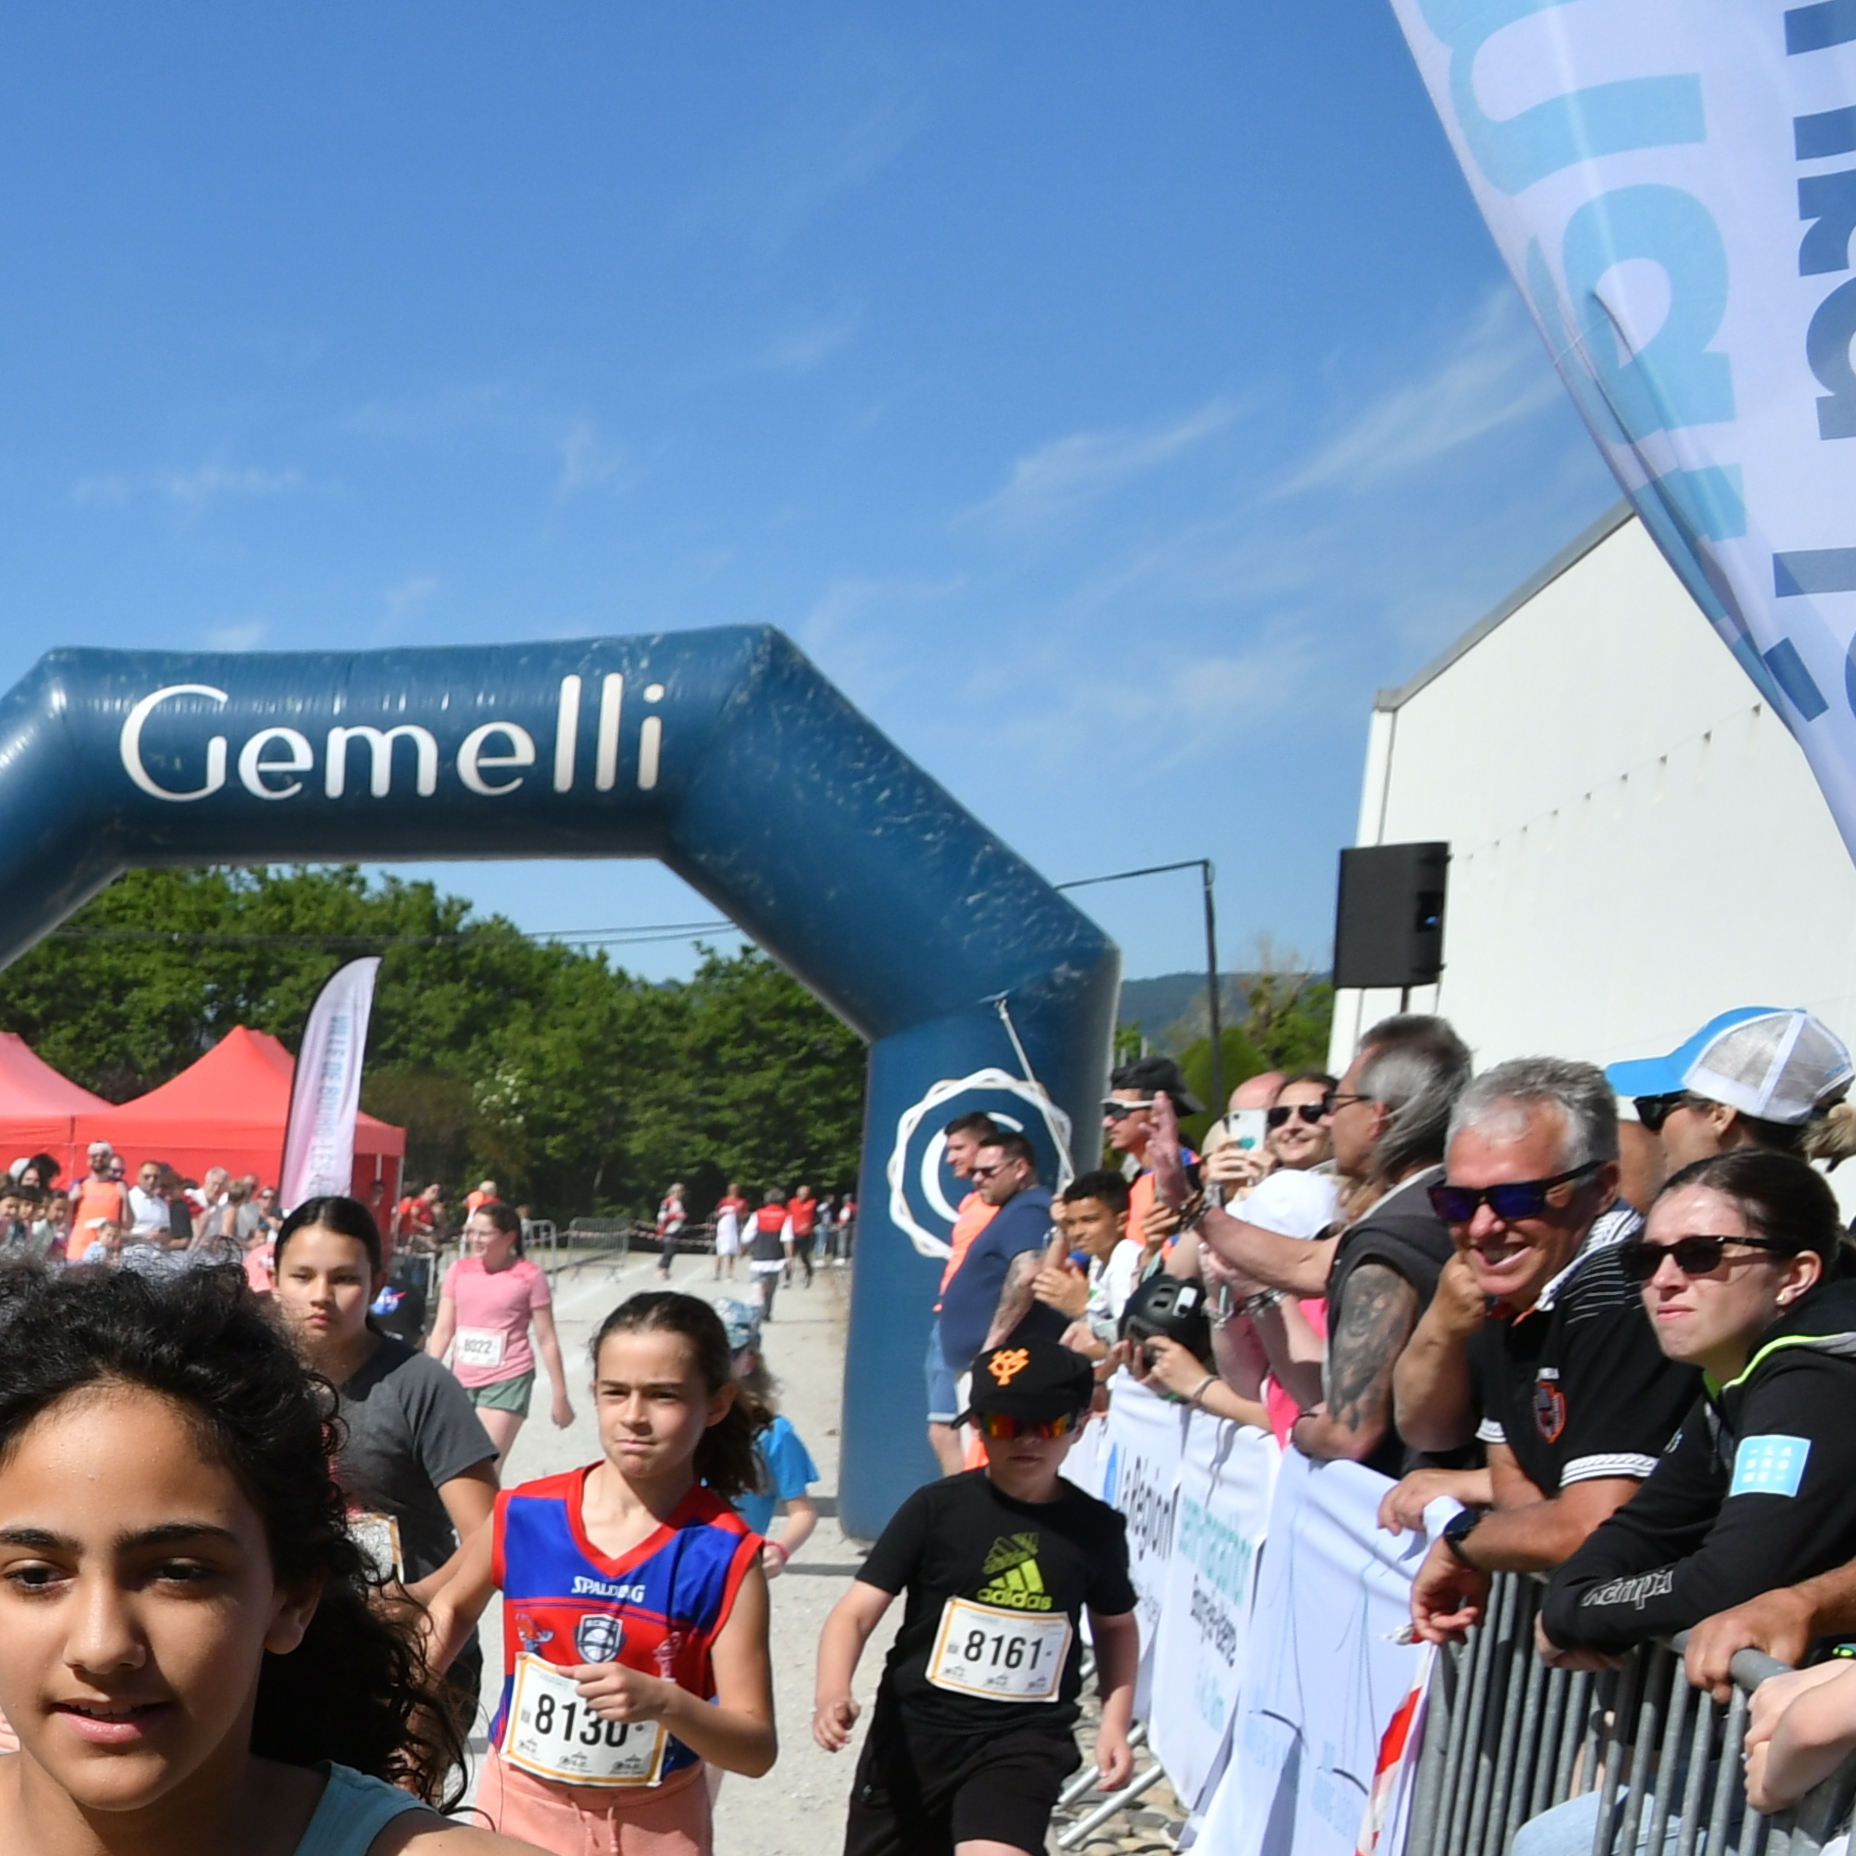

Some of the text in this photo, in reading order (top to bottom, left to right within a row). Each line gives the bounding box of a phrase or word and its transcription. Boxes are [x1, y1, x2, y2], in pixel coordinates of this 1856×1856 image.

[119, 672, 665, 802] Gemelli
[976, 1588, 1053, 1612] adidas
[963, 1629, 1044, 1672] 8161
